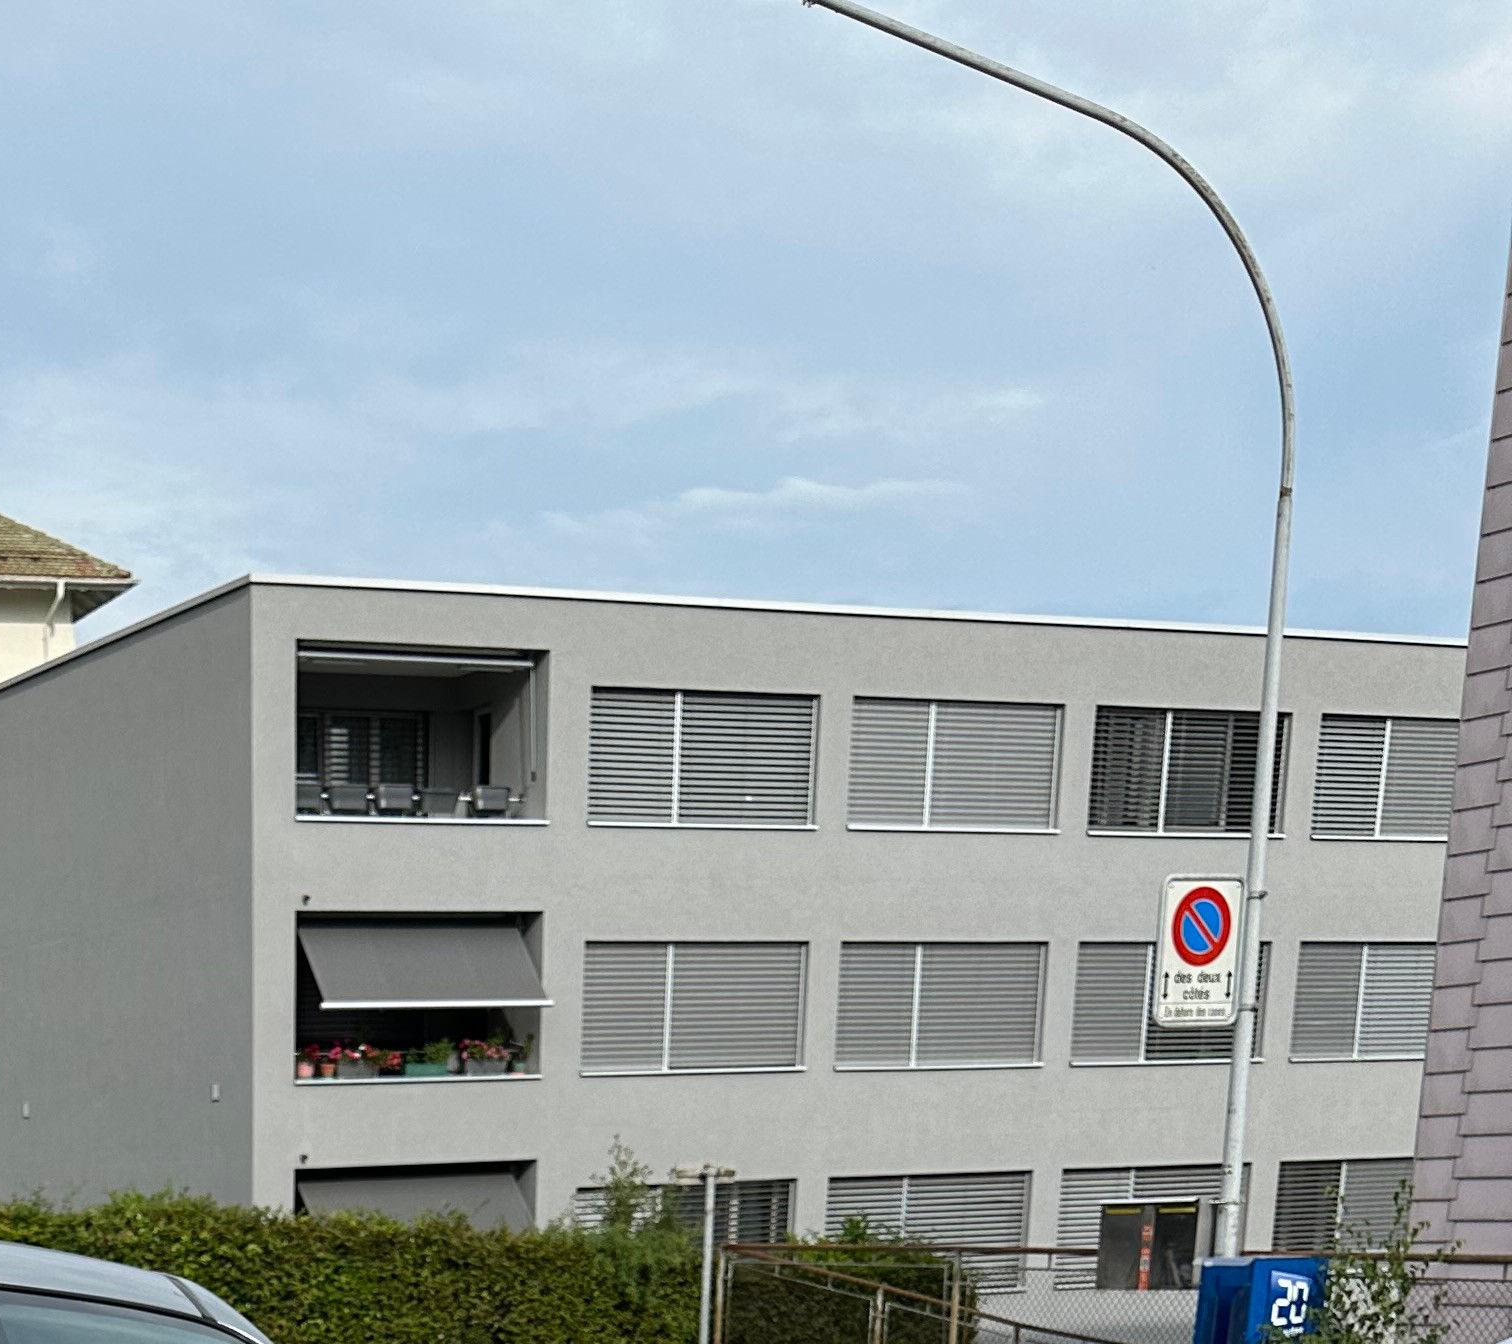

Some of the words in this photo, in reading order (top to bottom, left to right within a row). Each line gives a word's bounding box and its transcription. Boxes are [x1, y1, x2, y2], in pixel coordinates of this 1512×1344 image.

[1174, 971, 1193, 983] des
[1197, 970, 1221, 983] deux
[1271, 1278, 1310, 1326] 20
